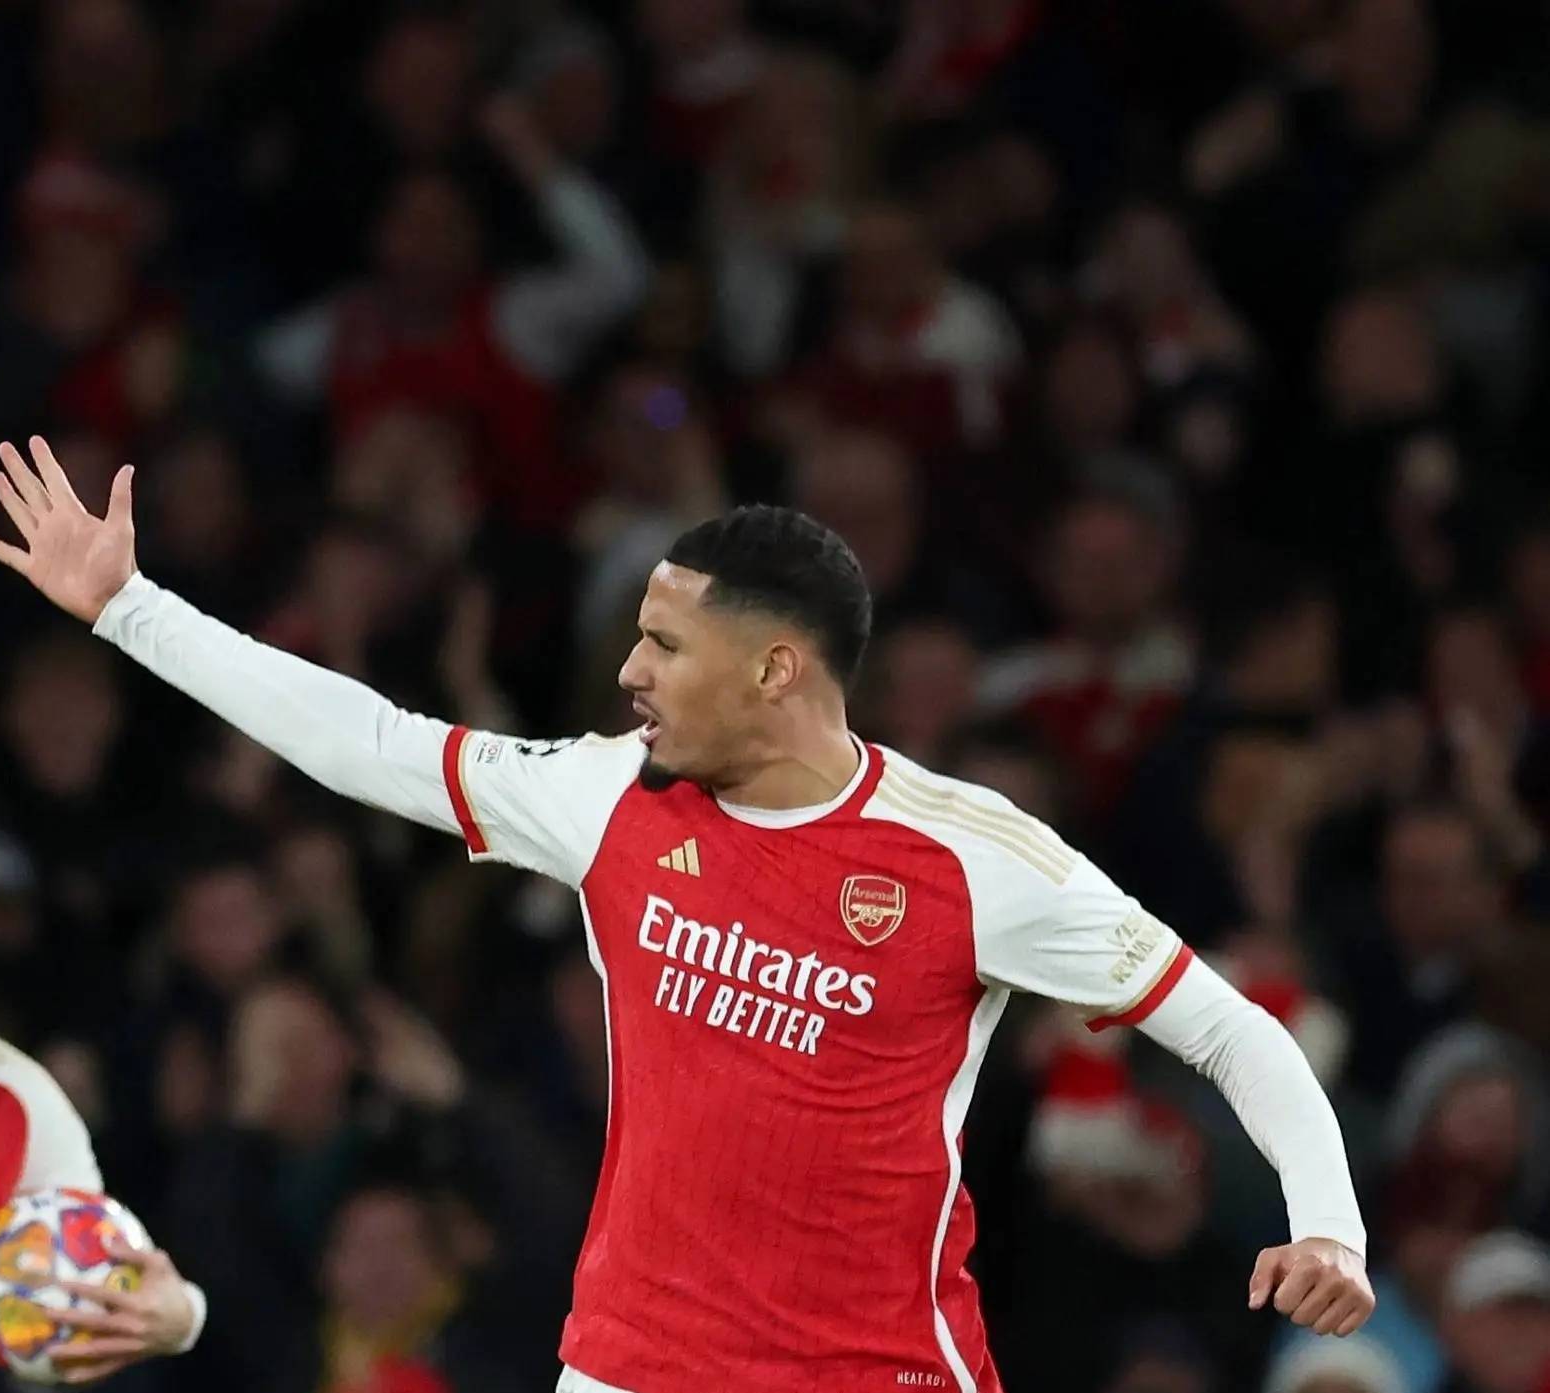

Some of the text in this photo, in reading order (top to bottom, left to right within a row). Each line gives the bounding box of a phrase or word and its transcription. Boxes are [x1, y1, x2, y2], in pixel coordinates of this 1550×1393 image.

[638, 894, 877, 1016] Emirates
[655, 966, 826, 1056] FLY BETTER
